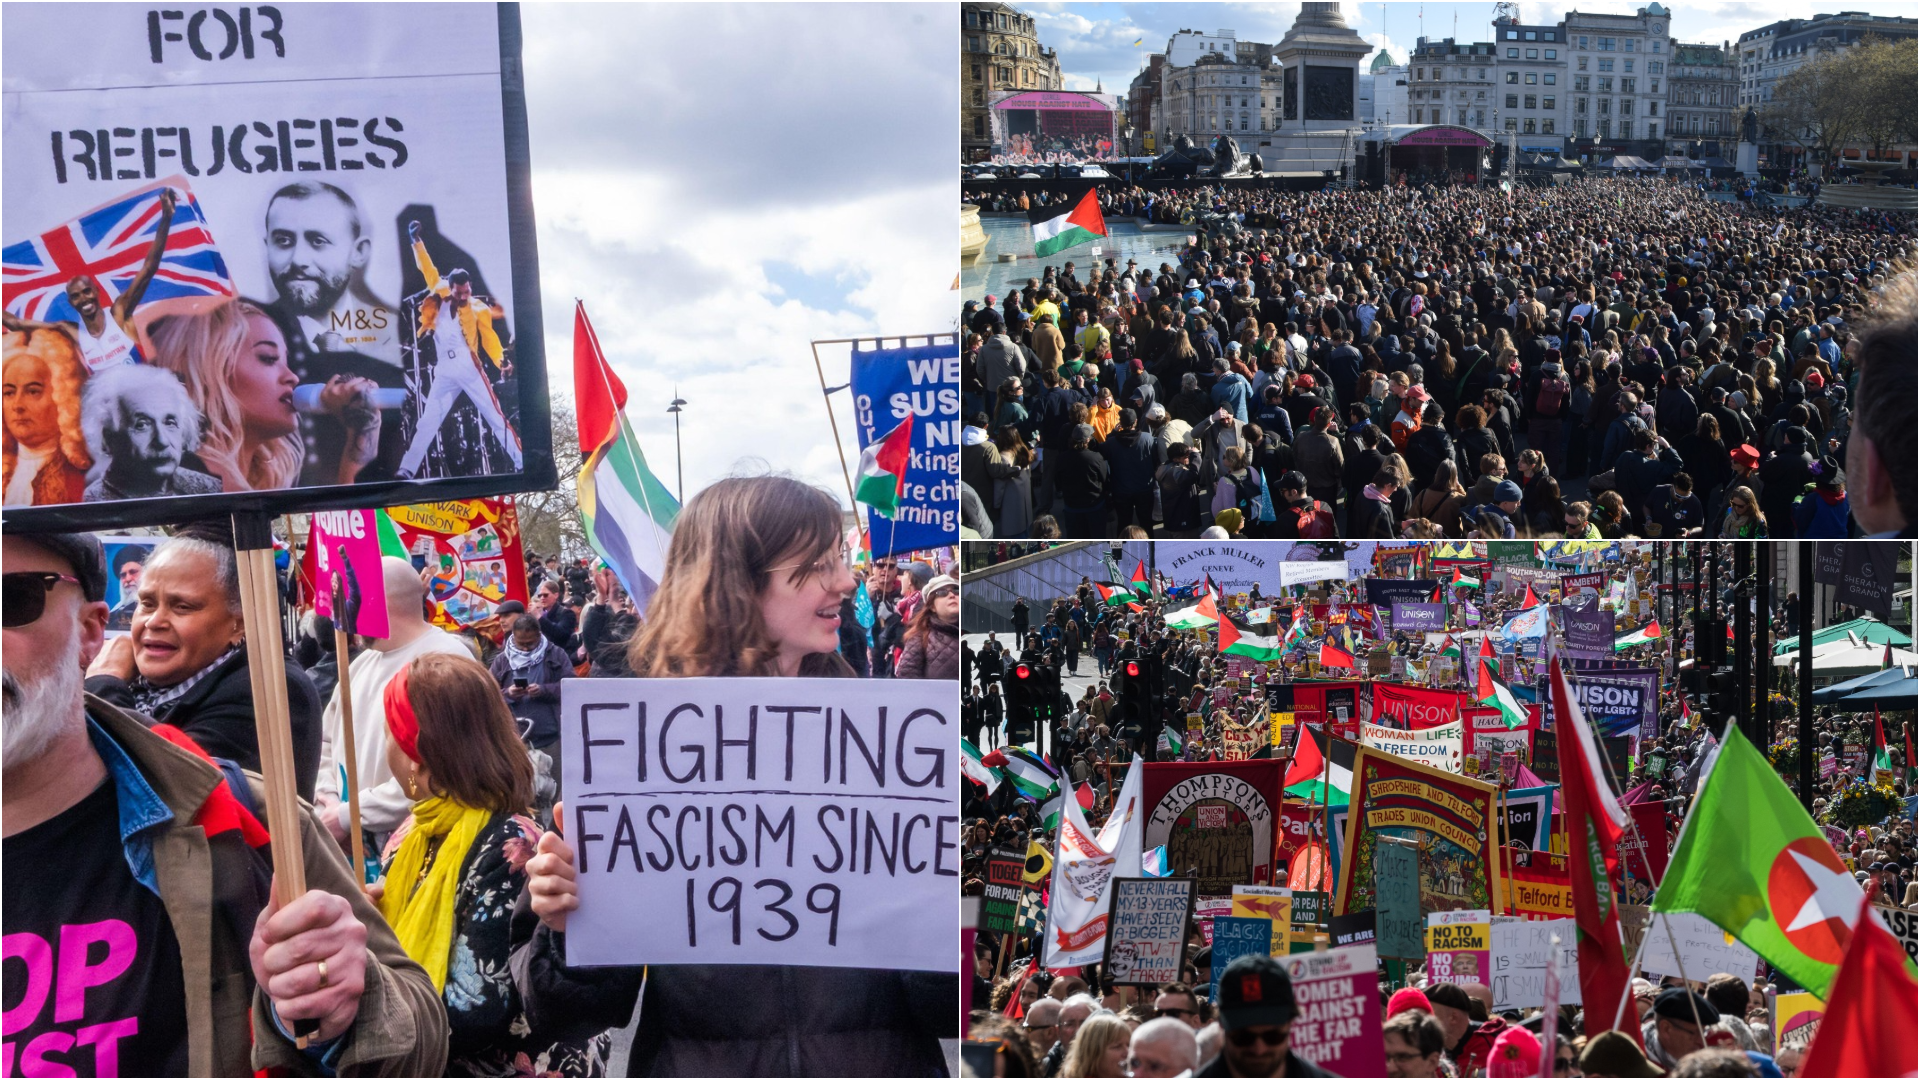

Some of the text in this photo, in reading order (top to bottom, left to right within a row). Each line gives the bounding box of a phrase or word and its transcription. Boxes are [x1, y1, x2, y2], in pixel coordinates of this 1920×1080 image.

[147, 5, 286, 64] FOR
[50, 116, 409, 184] REFUGEES
[331, 307, 388, 332] M&S
[406, 510, 455, 532] UNISON
[1171, 547, 1266, 569] FRANCK MULLER
[1201, 565, 1235, 573] GENEVE
[1849, 585, 1881, 599] GRAND
[1401, 610, 1435, 619] UNISON
[1604, 705, 1638, 715] LGBT+
[580, 701, 947, 788] FIGHTING
[1365, 727, 1456, 741] WOMAN LIFE
[1536, 739, 1548, 747] NO
[1383, 744, 1448, 757] FREEDOM
[1150, 775, 1269, 827] THOMPSONS
[1167, 790, 1259, 823] SOLICITORS
[1199, 807, 1225, 816] UNION
[1370, 780, 1481, 827] SHROPSHIRE AND TELFORD
[1198, 818, 1226, 829] VICTORY
[1372, 809, 1479, 853] TRADES UNION COUNCIL
[575, 804, 959, 877] FASCISM SINCE
[1380, 850, 1409, 880] MAKE
[984, 884, 1002, 897] FOR
[1378, 877, 1413, 904] GOOD
[1518, 886, 1560, 908] Telford
[686, 876, 842, 947] 1939
[1294, 911, 1316, 922] AND
[1221, 920, 1267, 940] LACK
[1379, 909, 1421, 944] TROUBLE
[1433, 925, 1473, 938] NO TO
[1336, 930, 1375, 945] WE ARE
[1433, 937, 1483, 949] RACISM
[1432, 952, 1452, 965] NO
[1431, 964, 1451, 976] TO
[1324, 1017, 1363, 1040] FAR
